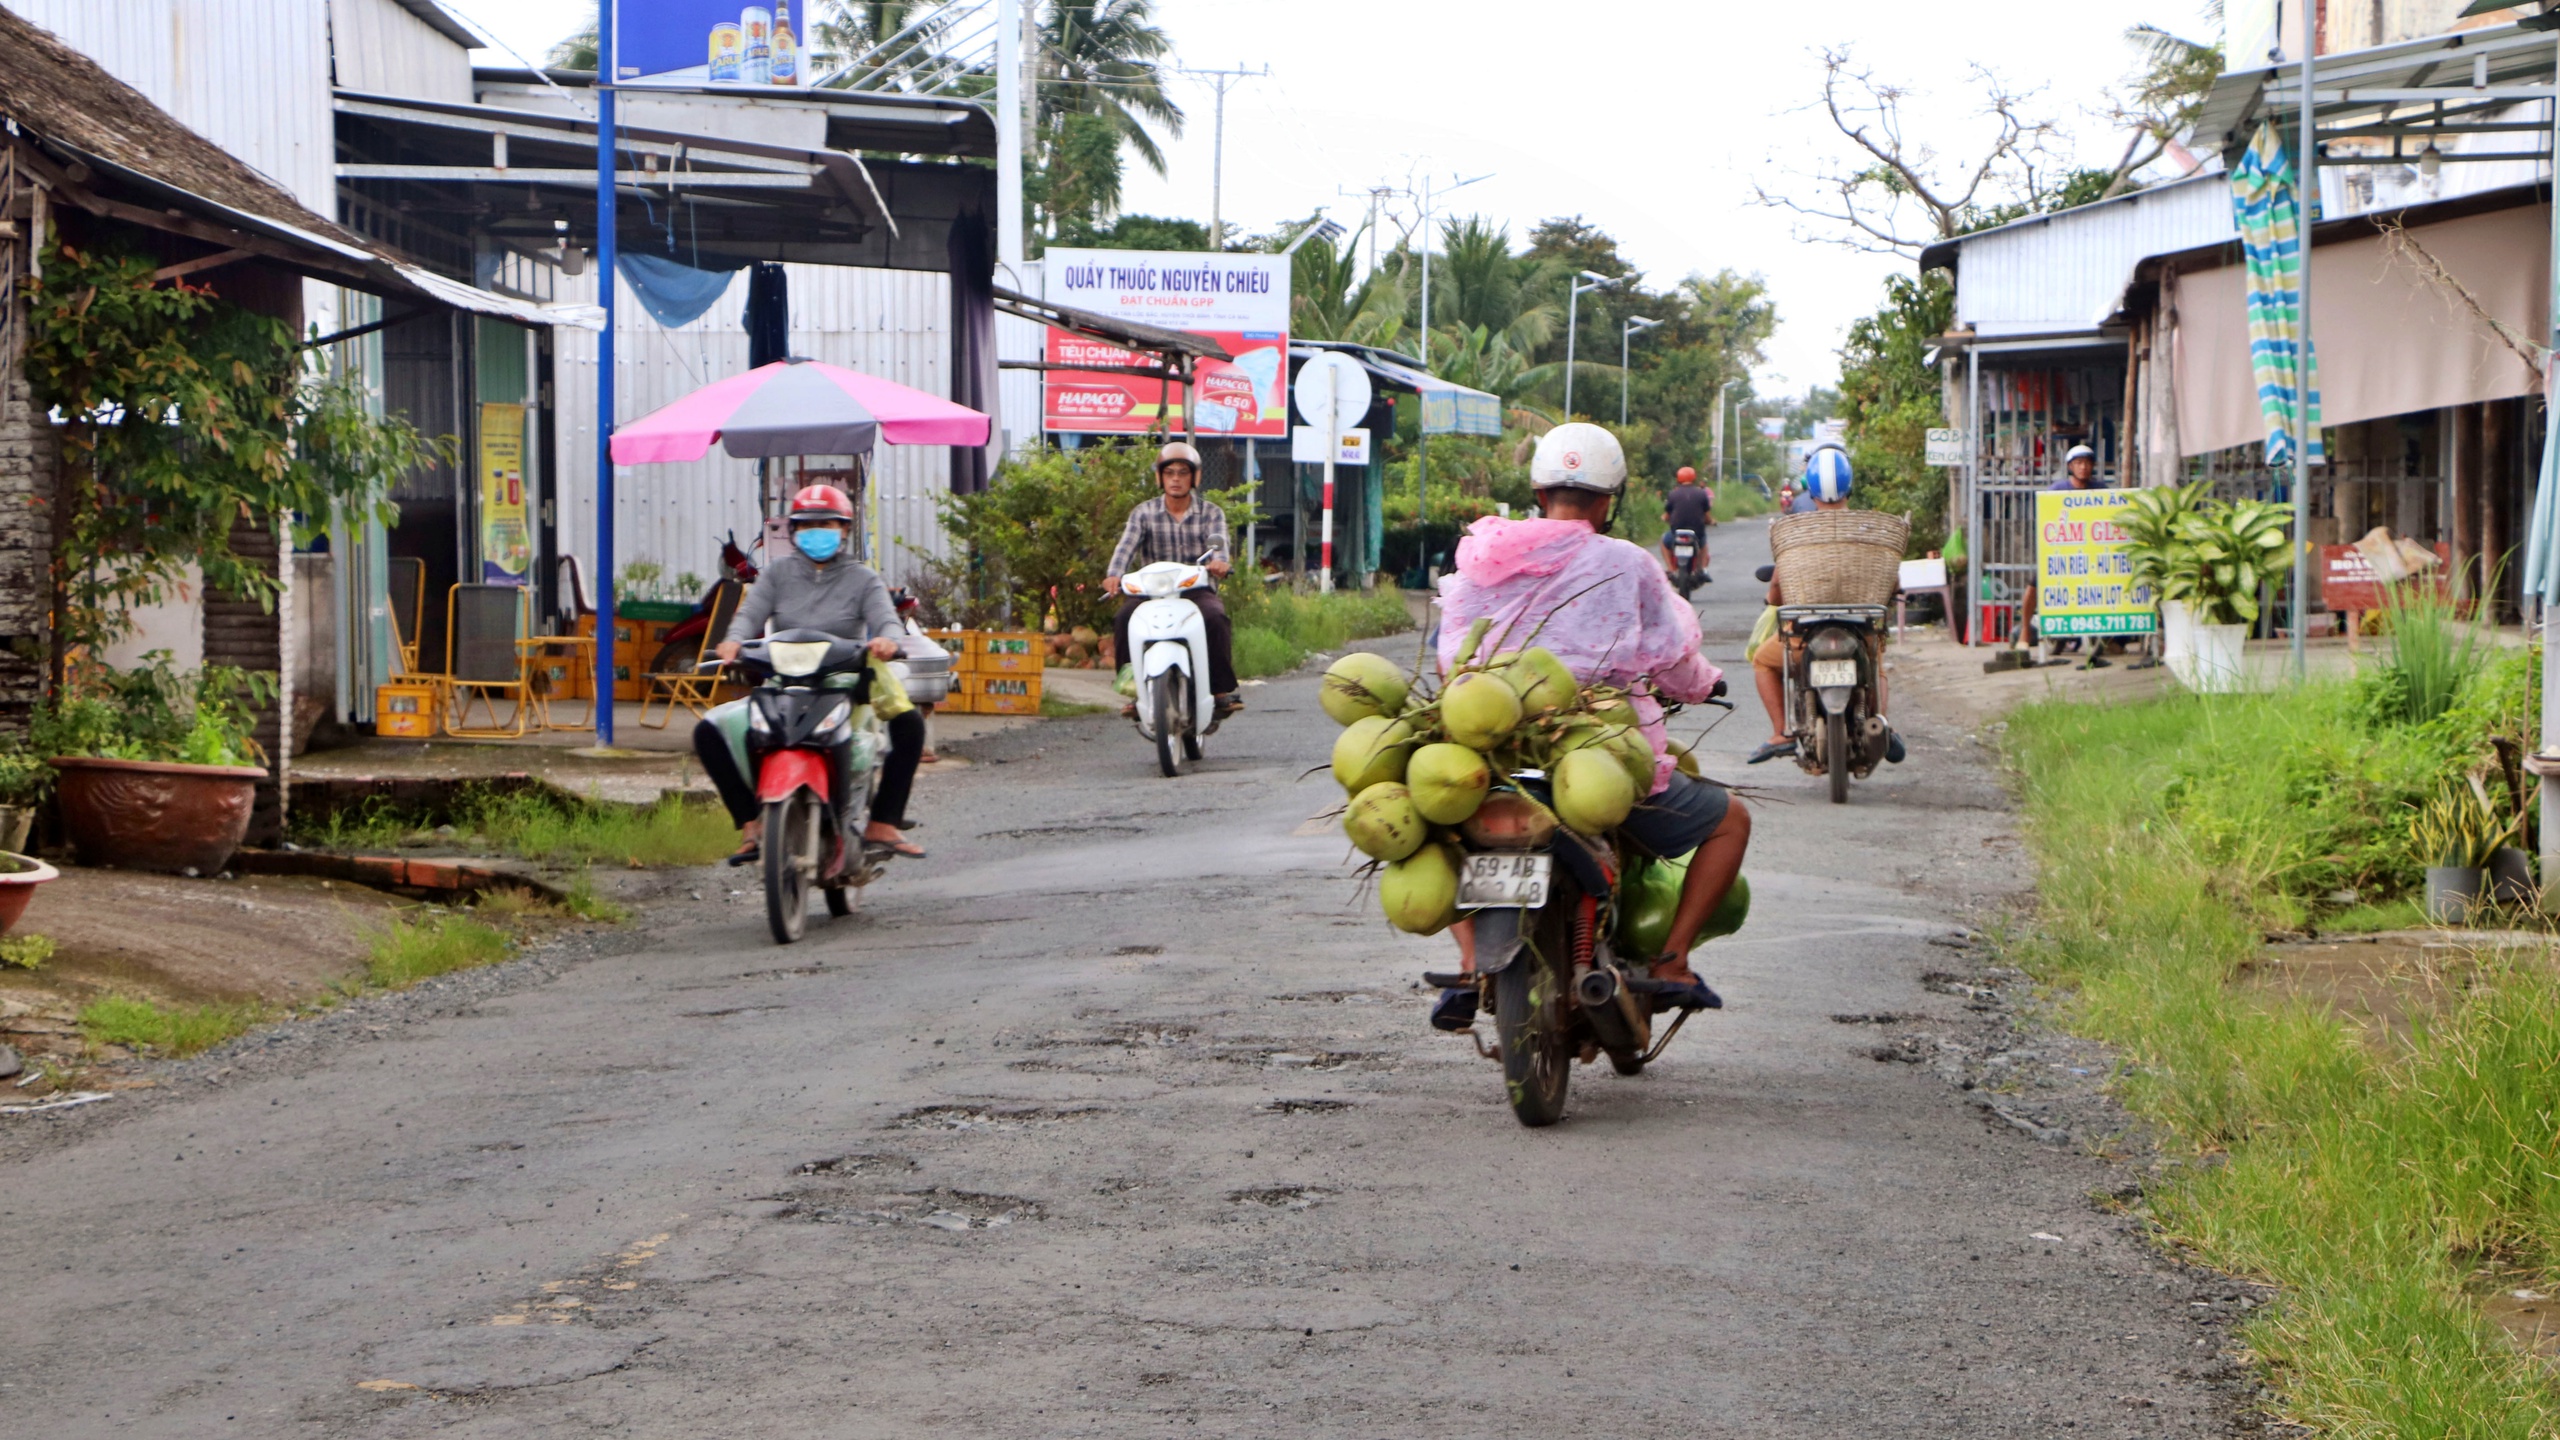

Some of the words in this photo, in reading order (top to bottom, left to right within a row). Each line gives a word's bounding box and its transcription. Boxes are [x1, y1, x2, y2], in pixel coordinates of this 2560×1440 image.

[1109, 259, 1156, 290] THUỐC
[1161, 261, 1221, 292] NGUYỄN
[1191, 297, 1214, 307] GPP
[1205, 376, 1250, 391] HAPACOL
[1058, 392, 1127, 405] HAPACOL
[1223, 395, 1249, 409] 650
[2064, 493, 2103, 508] QUÁN
[2043, 509, 2085, 543] CẨM
[2047, 549, 2066, 576] BÚN
[2069, 548, 2088, 575] RIÊU
[2044, 580, 2069, 607] CHÁO
[2077, 580, 2103, 606] BÁNH
[2044, 617, 2068, 632] ĐT:
[2070, 616, 2126, 632] 0945.711
[2129, 615, 2151, 631] 781
[1475, 857, 1537, 878] 69-AB
